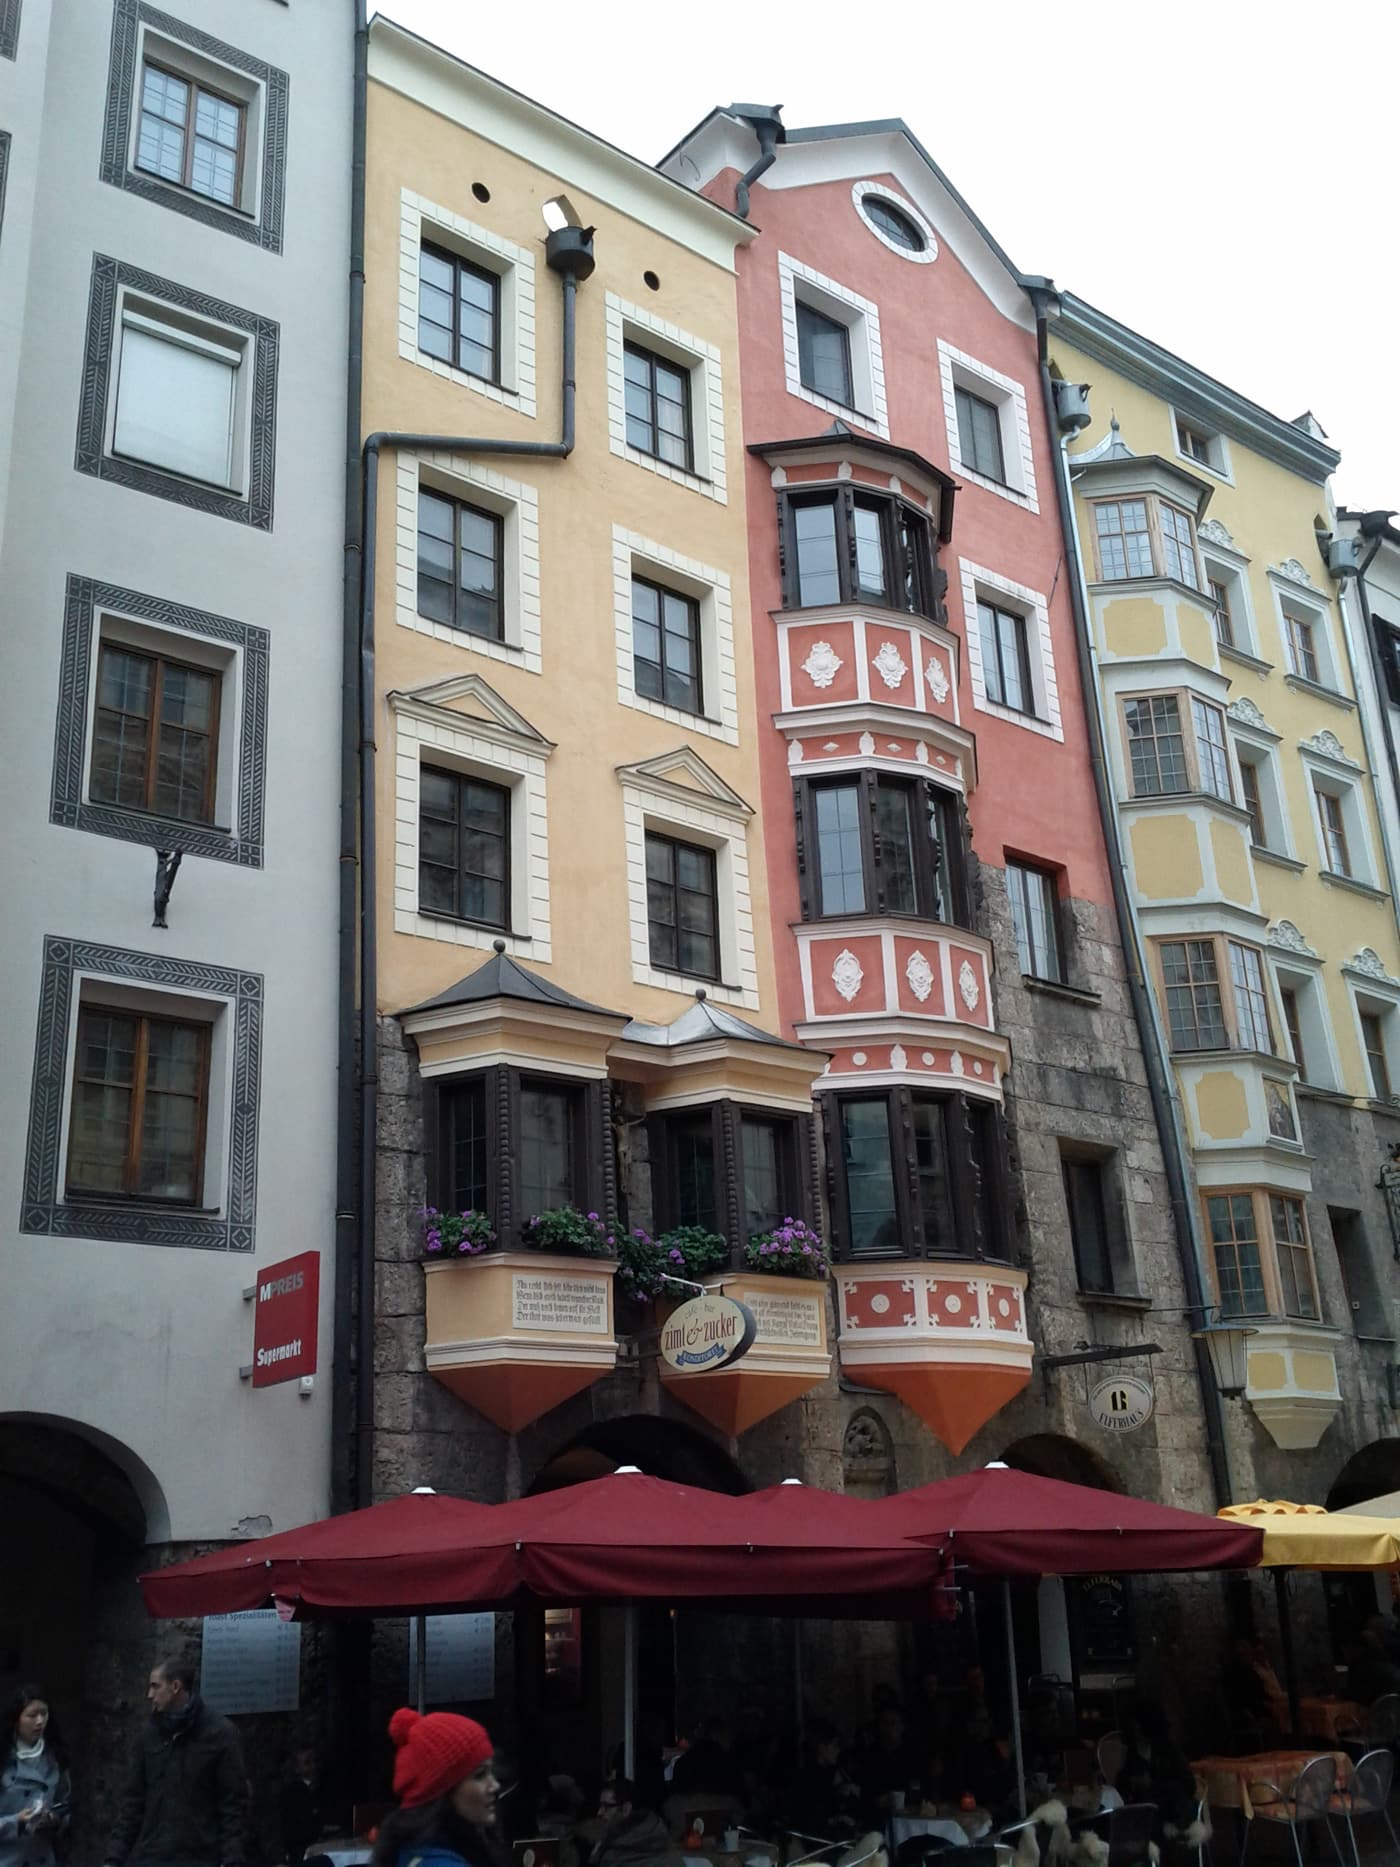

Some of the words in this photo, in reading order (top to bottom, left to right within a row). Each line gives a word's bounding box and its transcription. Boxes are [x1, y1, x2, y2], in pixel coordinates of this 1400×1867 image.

[259, 1272, 304, 1303] MPREIS
[703, 1311, 738, 1342] zucker
[257, 1338, 302, 1367] Supermarkt
